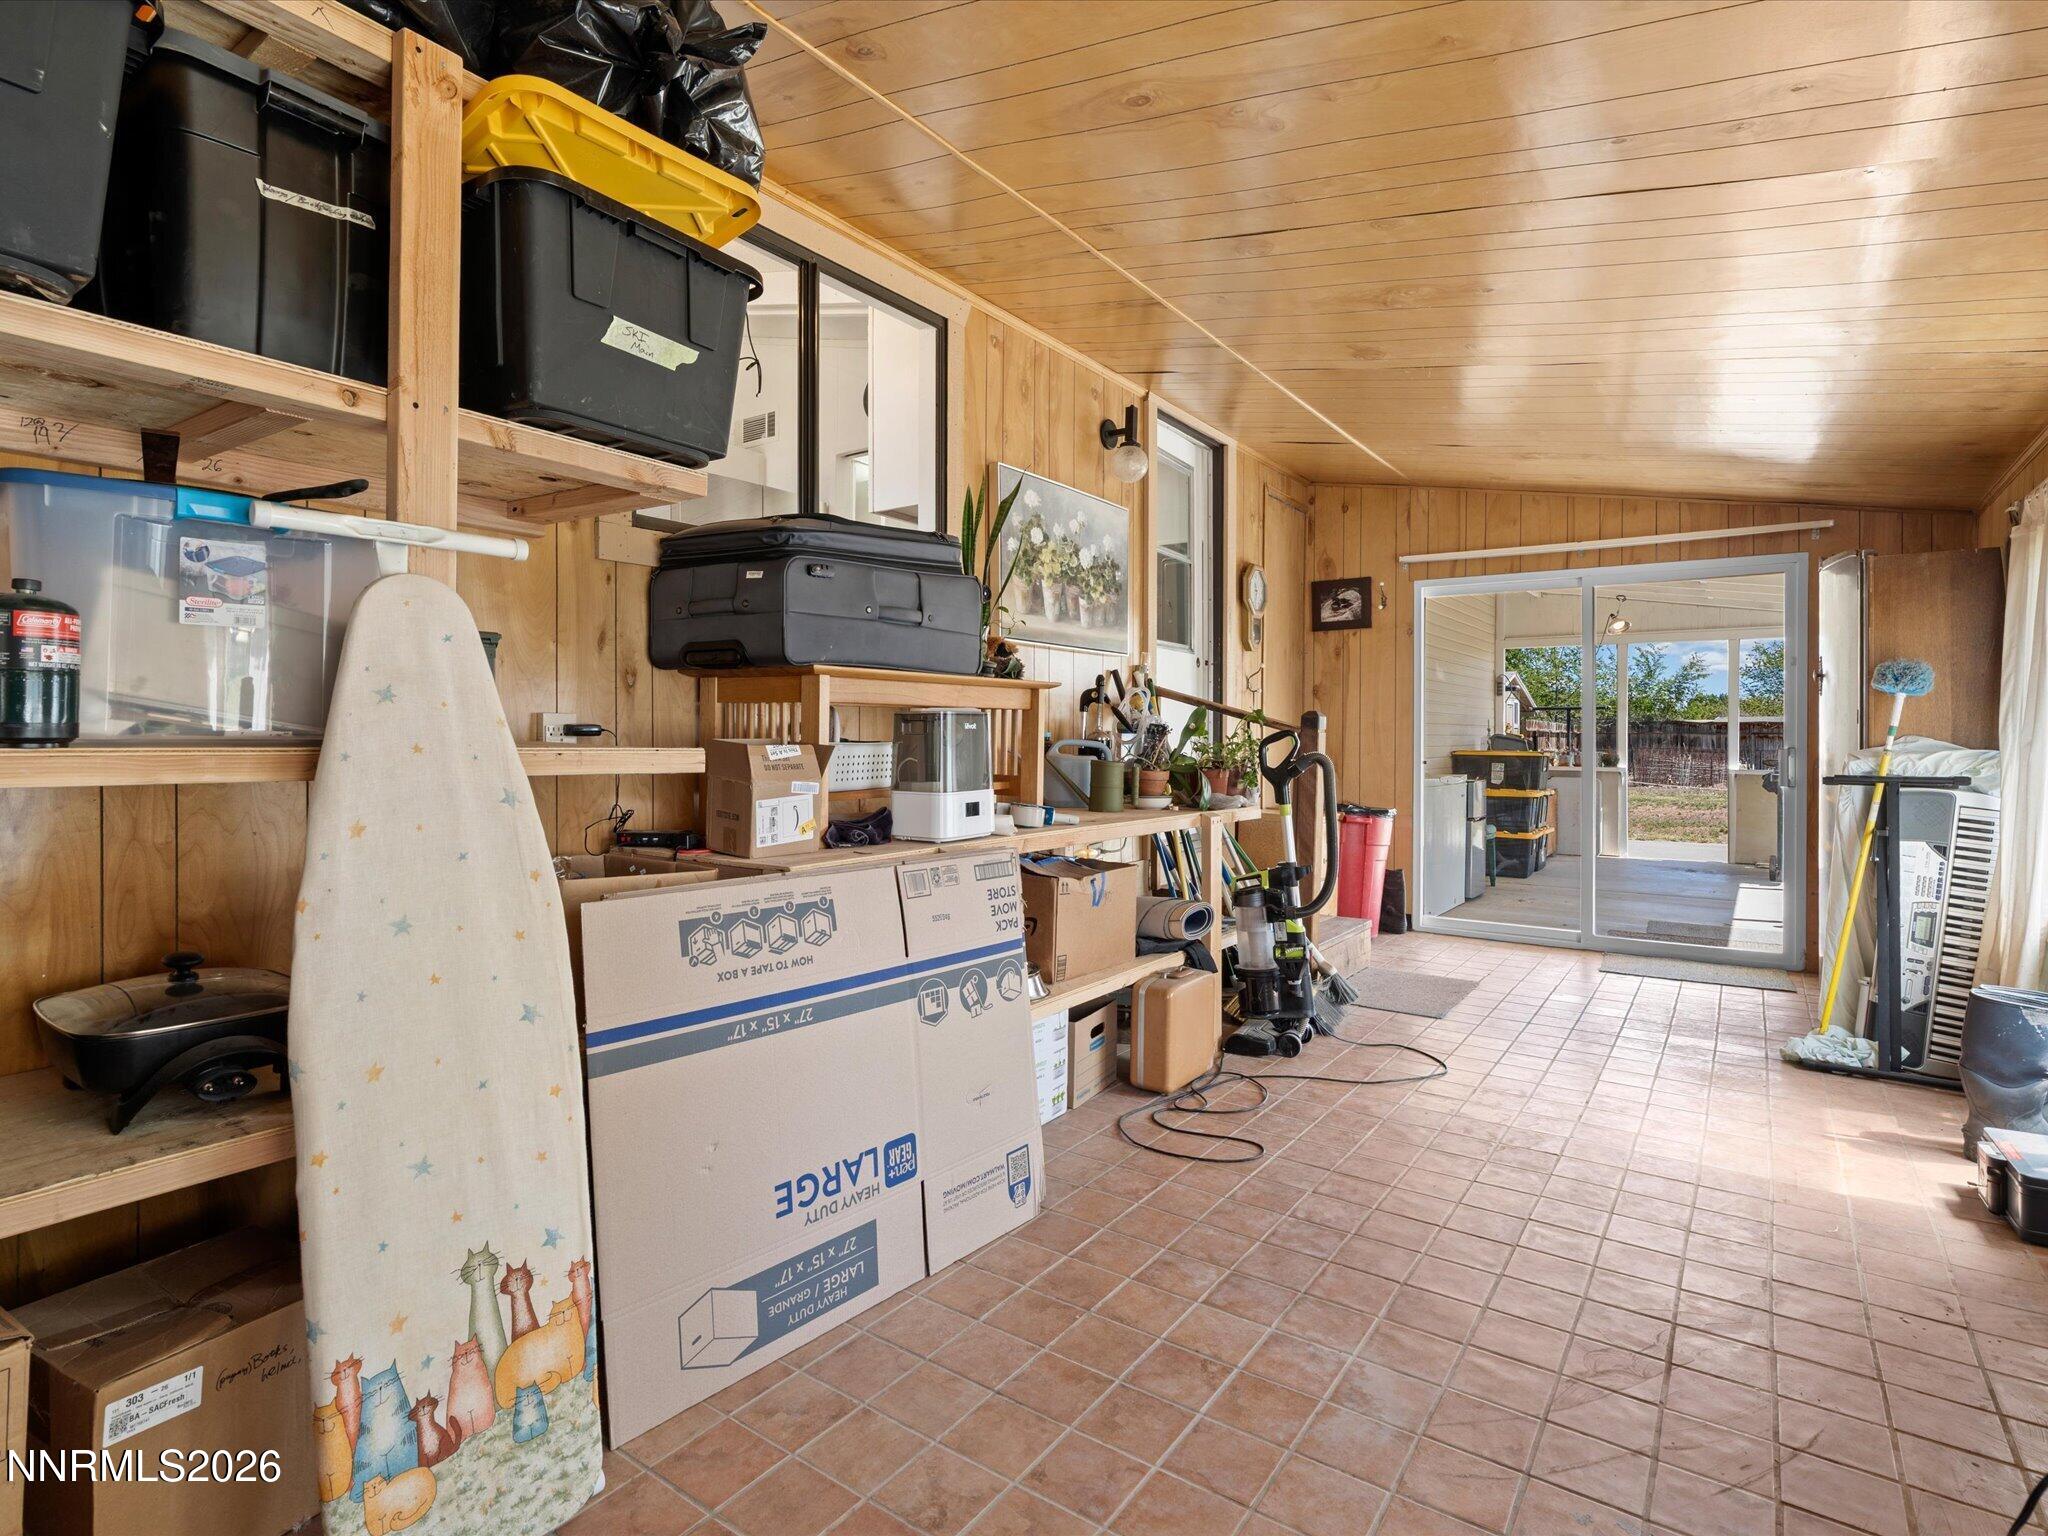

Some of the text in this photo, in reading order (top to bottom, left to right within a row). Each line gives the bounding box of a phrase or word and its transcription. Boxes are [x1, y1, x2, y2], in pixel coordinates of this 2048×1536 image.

[987, 886, 1016, 900] STORE
[991, 902, 1017, 916] MOVE
[996, 917, 1018, 932] PACK
[717, 955, 814, 982] HOW TO TAPE A BOX
[728, 1008, 814, 1041] 27" x 15" x 17"
[889, 1142, 912, 1166] GEAR
[774, 1146, 878, 1219] LARGE
[943, 1164, 1005, 1199] WALMART.COM/MOVING
[804, 1182, 880, 1227] HEAVY DUTY
[775, 1236, 857, 1288] 27" x 15" x 17"
[768, 1260, 864, 1317] LARGE / GRANDE
[788, 1286, 847, 1326] HEAVY DUTY
[184, 1372, 196, 1381] 1/1
[126, 1393, 144, 1408] 303
[129, 1413, 140, 1422] BA
[149, 1394, 185, 1414] SACFresh
